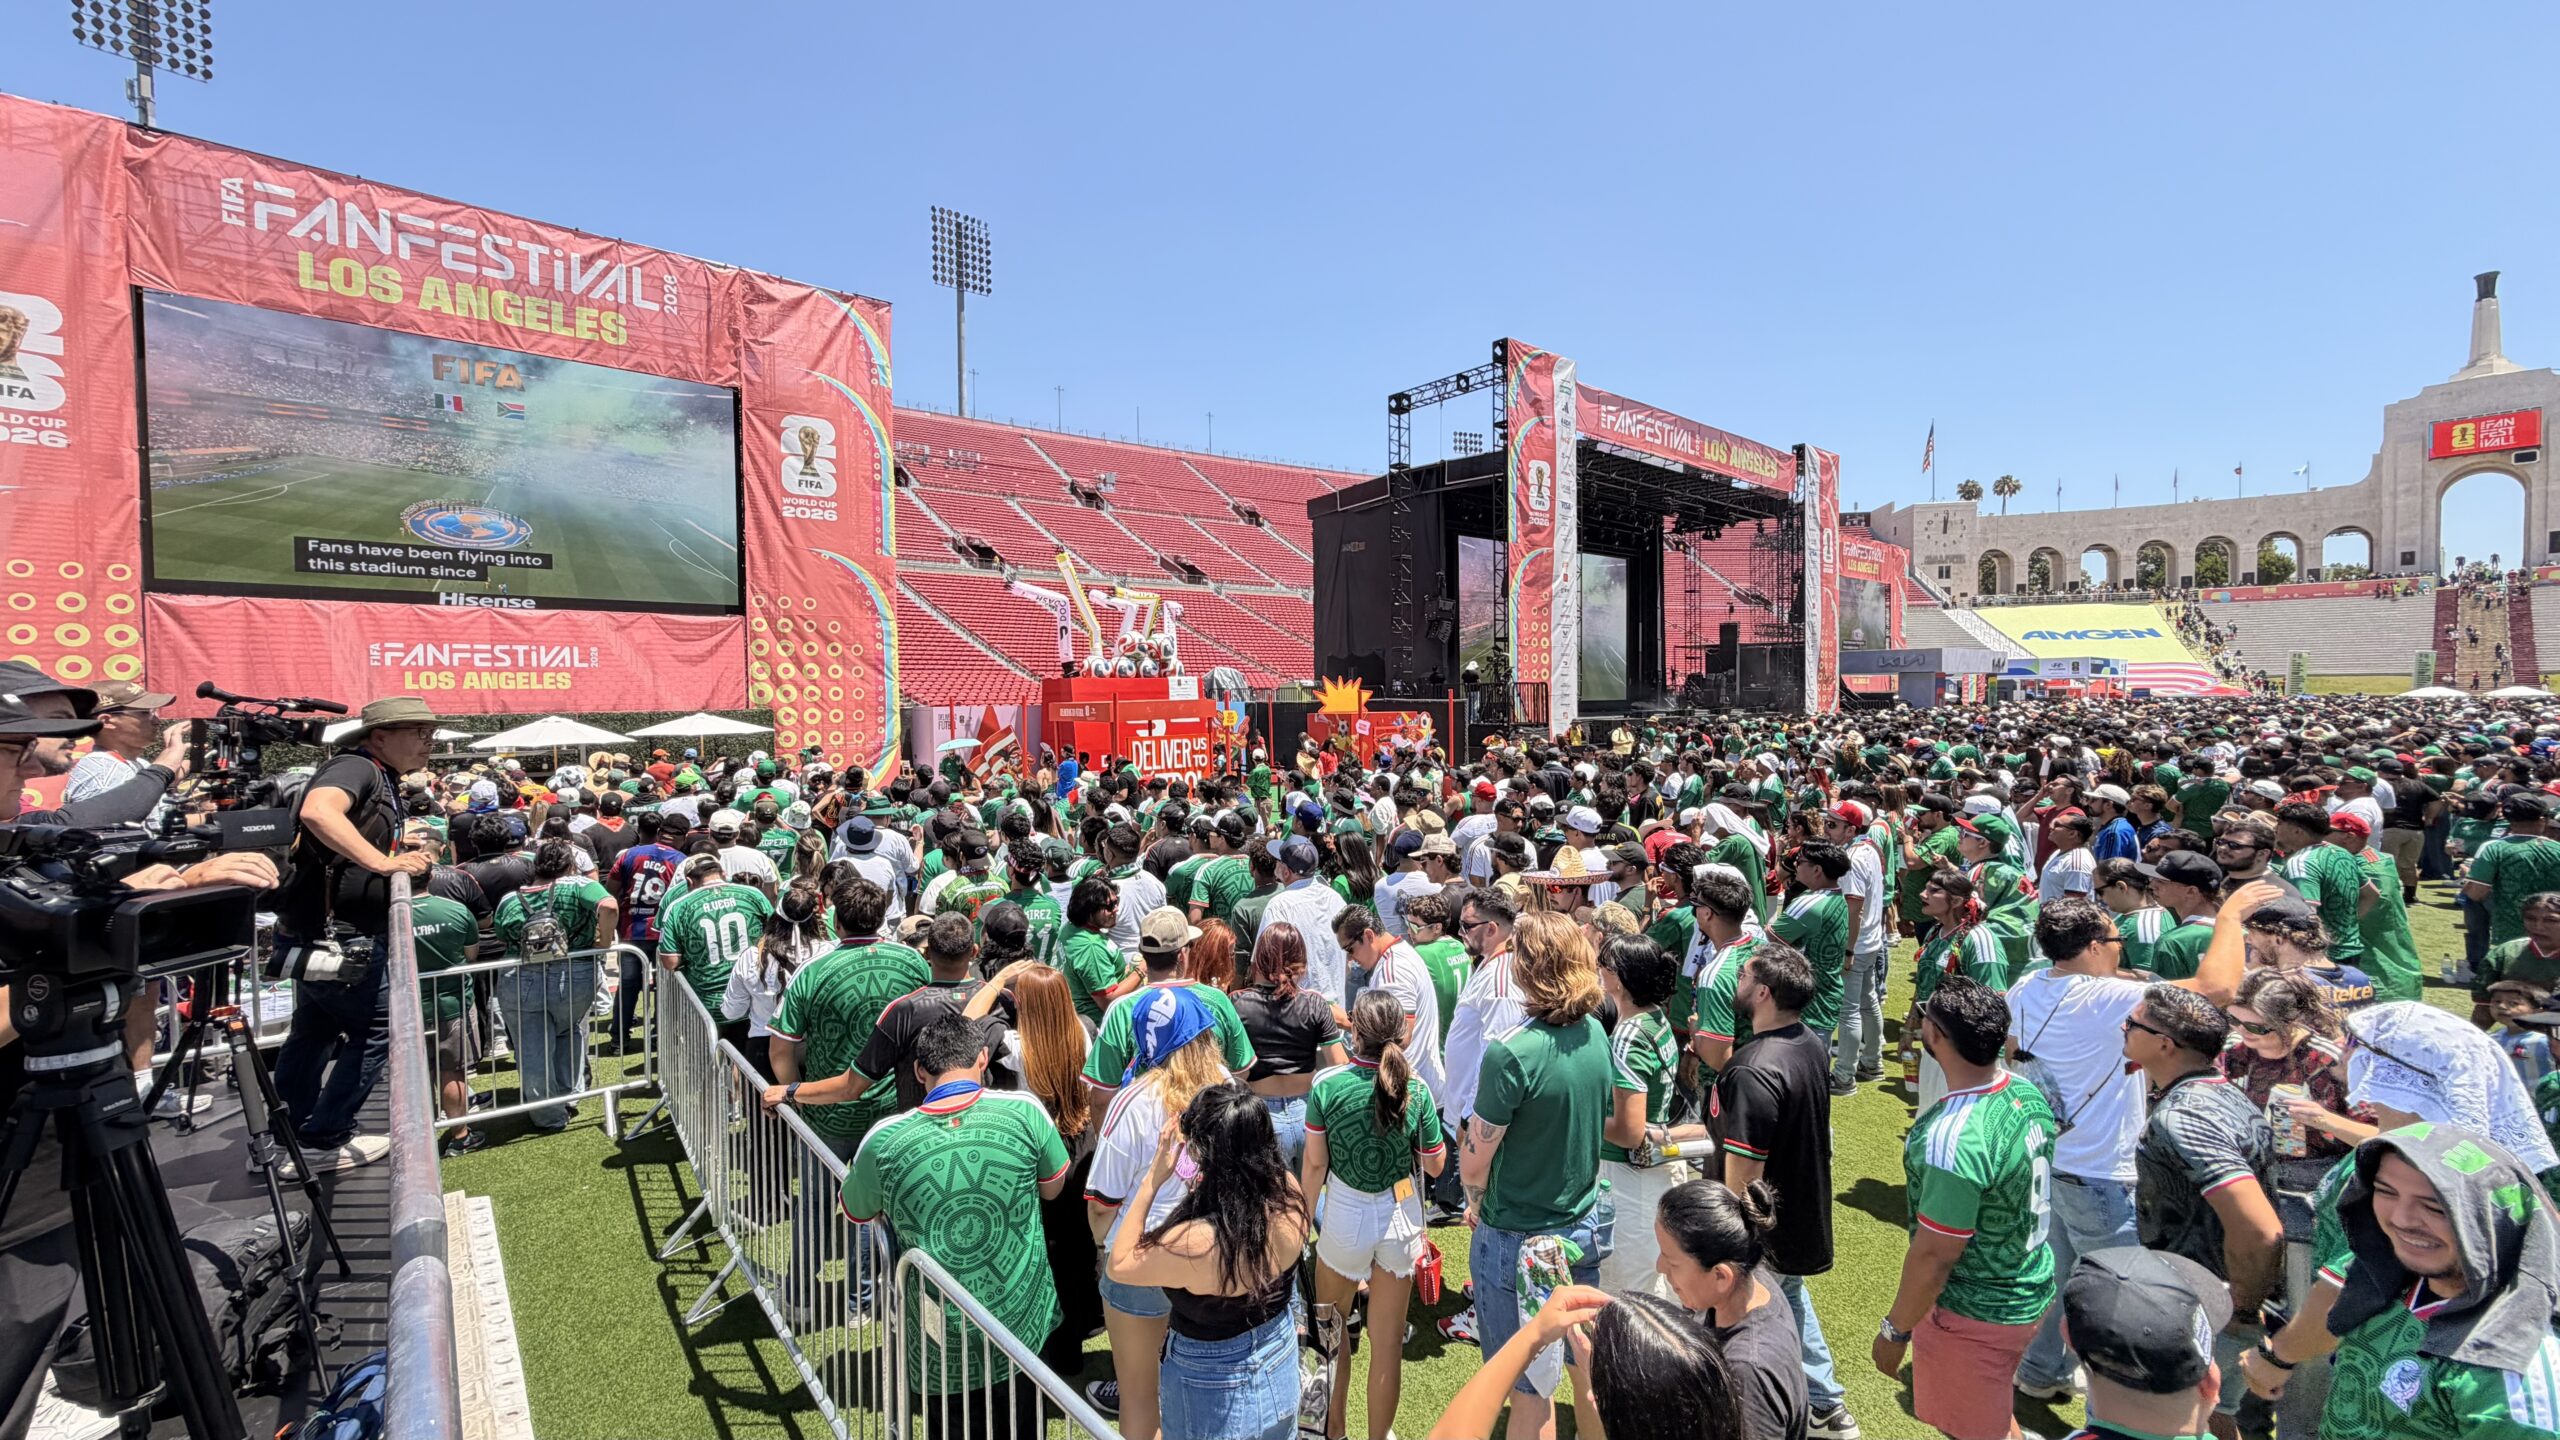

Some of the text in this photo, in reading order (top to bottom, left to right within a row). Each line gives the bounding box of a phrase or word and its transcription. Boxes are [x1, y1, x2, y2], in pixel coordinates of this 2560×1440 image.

[221, 177, 245, 227] FIFA
[663, 273, 678, 316] 2026
[298, 251, 627, 345] LOS ANGELES
[432, 353, 525, 392] FIFA
[28, 415, 67, 429] CUP
[1704, 437, 1728, 464] LOS
[1729, 446, 1778, 479] ANGELES
[798, 479, 823, 490] FIFA
[782, 497, 837, 508] WORLD CUP
[782, 506, 838, 521] 2026
[307, 539, 542, 567] Fans have been flying into
[308, 557, 477, 578] this stadium since
[439, 592, 536, 609] Hisense
[2022, 628, 2163, 640] AMGEN
[370, 642, 381, 666] FIFA
[591, 646, 599, 668] 2026
[1877, 654, 1926, 668] KIA
[404, 671, 572, 689] LOS ANGELES
[1132, 739, 1191, 770] DELIVER
[1193, 737, 1208, 750] US
[1193, 754, 1208, 767] TO
[643, 860, 666, 874] DECO
[703, 897, 736, 913] A.VEGA
[700, 912, 748, 965] 10
[2026, 1156, 2051, 1252] 9
